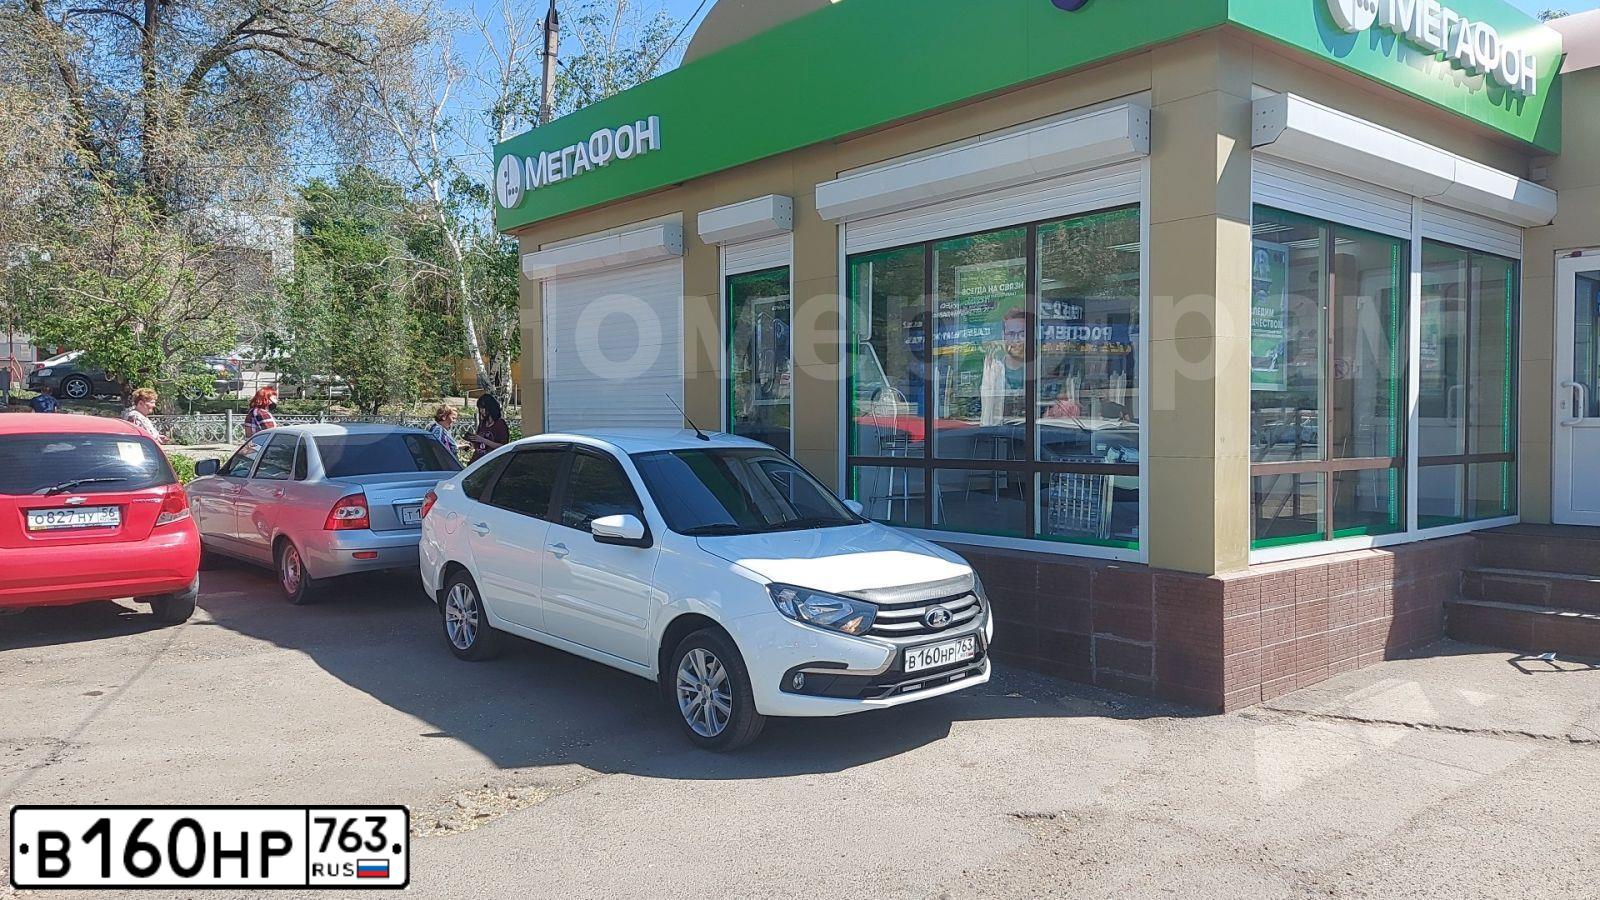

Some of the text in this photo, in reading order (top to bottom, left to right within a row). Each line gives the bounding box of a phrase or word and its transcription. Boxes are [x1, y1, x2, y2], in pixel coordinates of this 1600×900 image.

[1252, 306, 1274, 317] ЛЕДИМ
[101, 507, 115, 518] 56
[908, 638, 973, 669] В160НР 763
